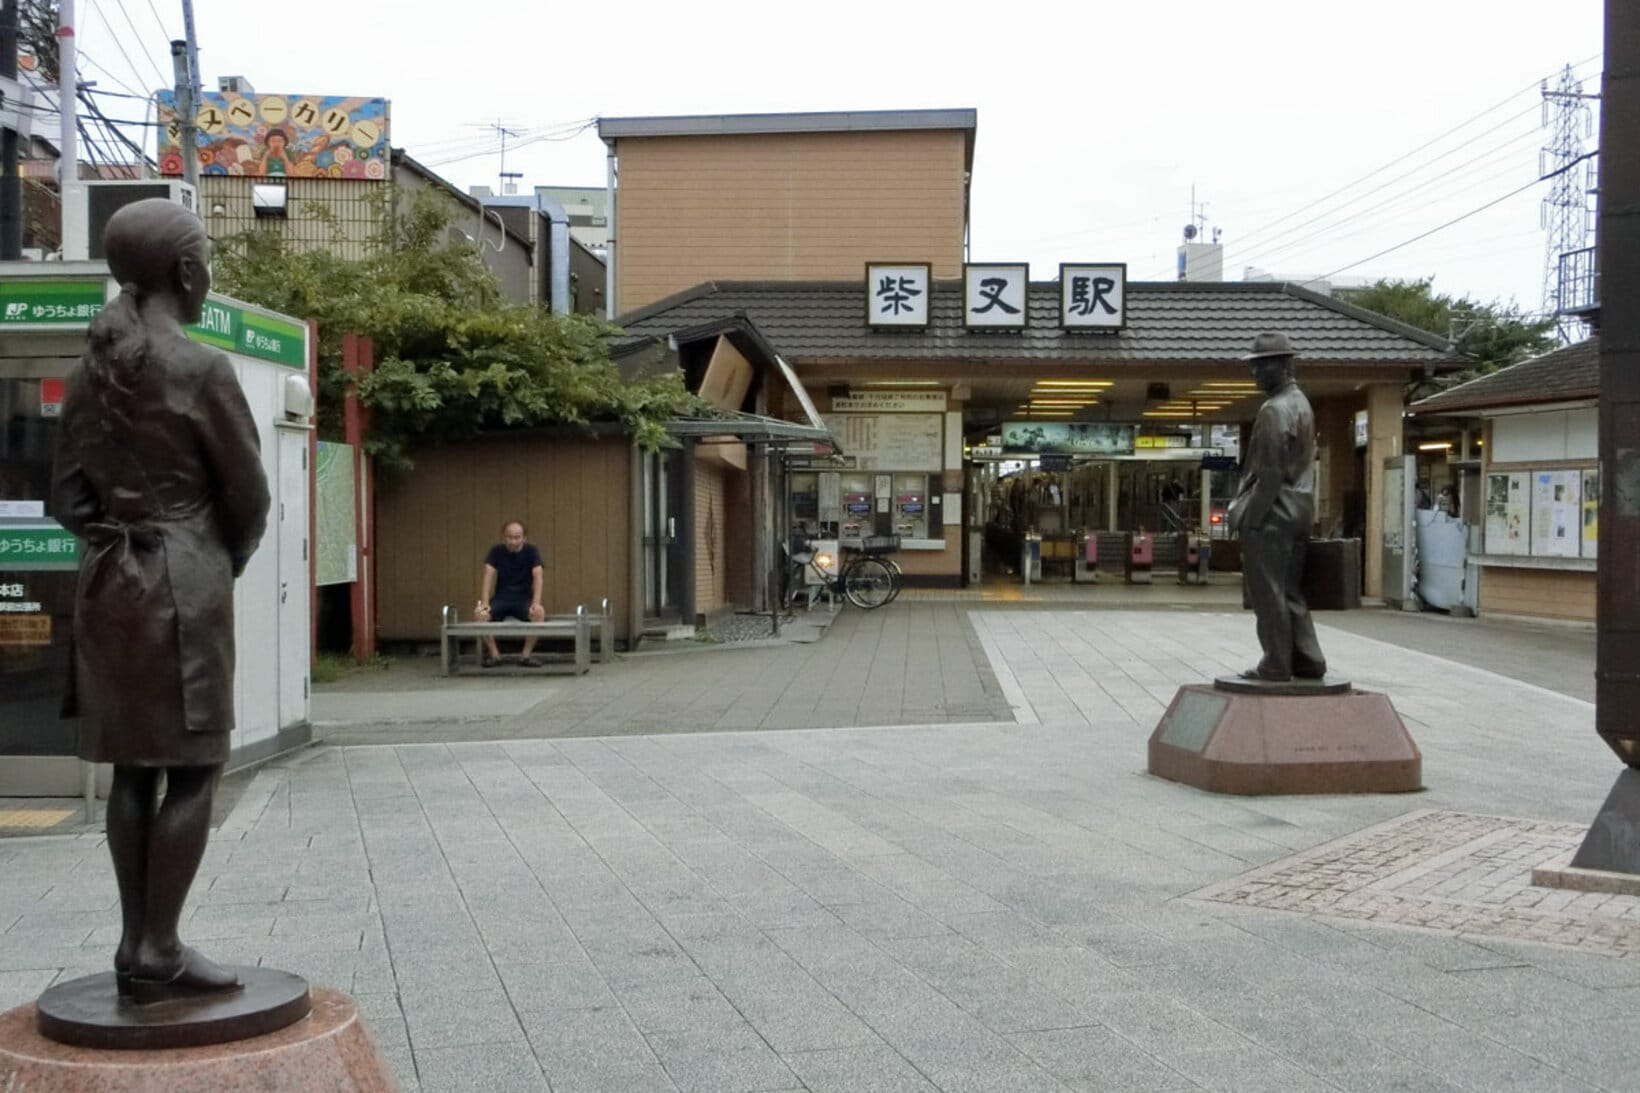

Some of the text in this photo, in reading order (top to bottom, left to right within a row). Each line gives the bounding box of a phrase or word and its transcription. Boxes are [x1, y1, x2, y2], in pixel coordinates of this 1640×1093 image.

[876, 276, 1118, 317] 柴又駅
[0, 538, 76, 553] ゆうちょ銀行
